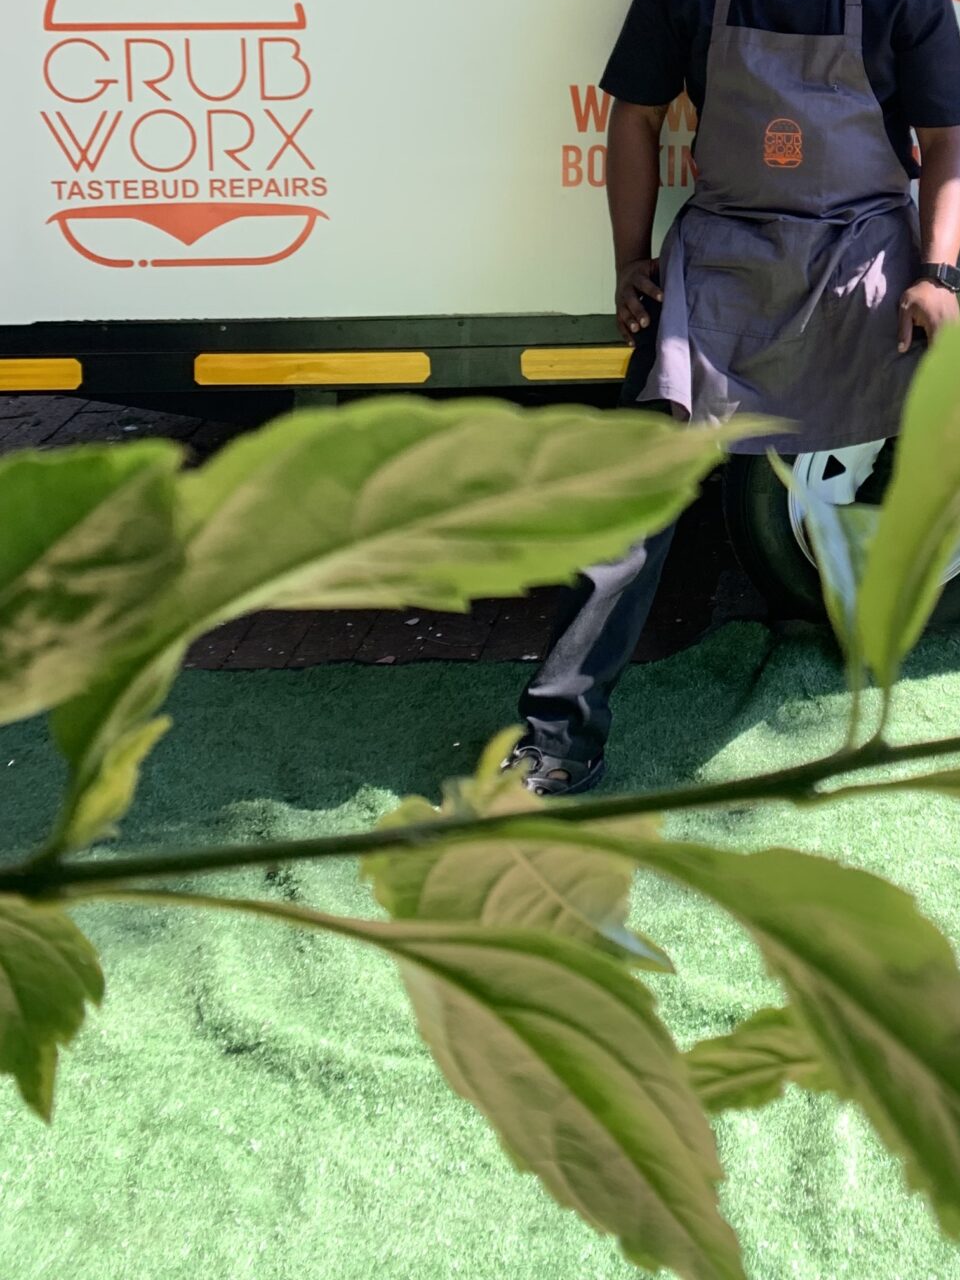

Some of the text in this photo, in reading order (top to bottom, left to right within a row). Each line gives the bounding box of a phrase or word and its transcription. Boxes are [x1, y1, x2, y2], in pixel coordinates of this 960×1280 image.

[43, 38, 311, 103] GRUB
[40, 109, 316, 173] WORX
[51, 177, 328, 200] TASTEBUD REPAIRS
